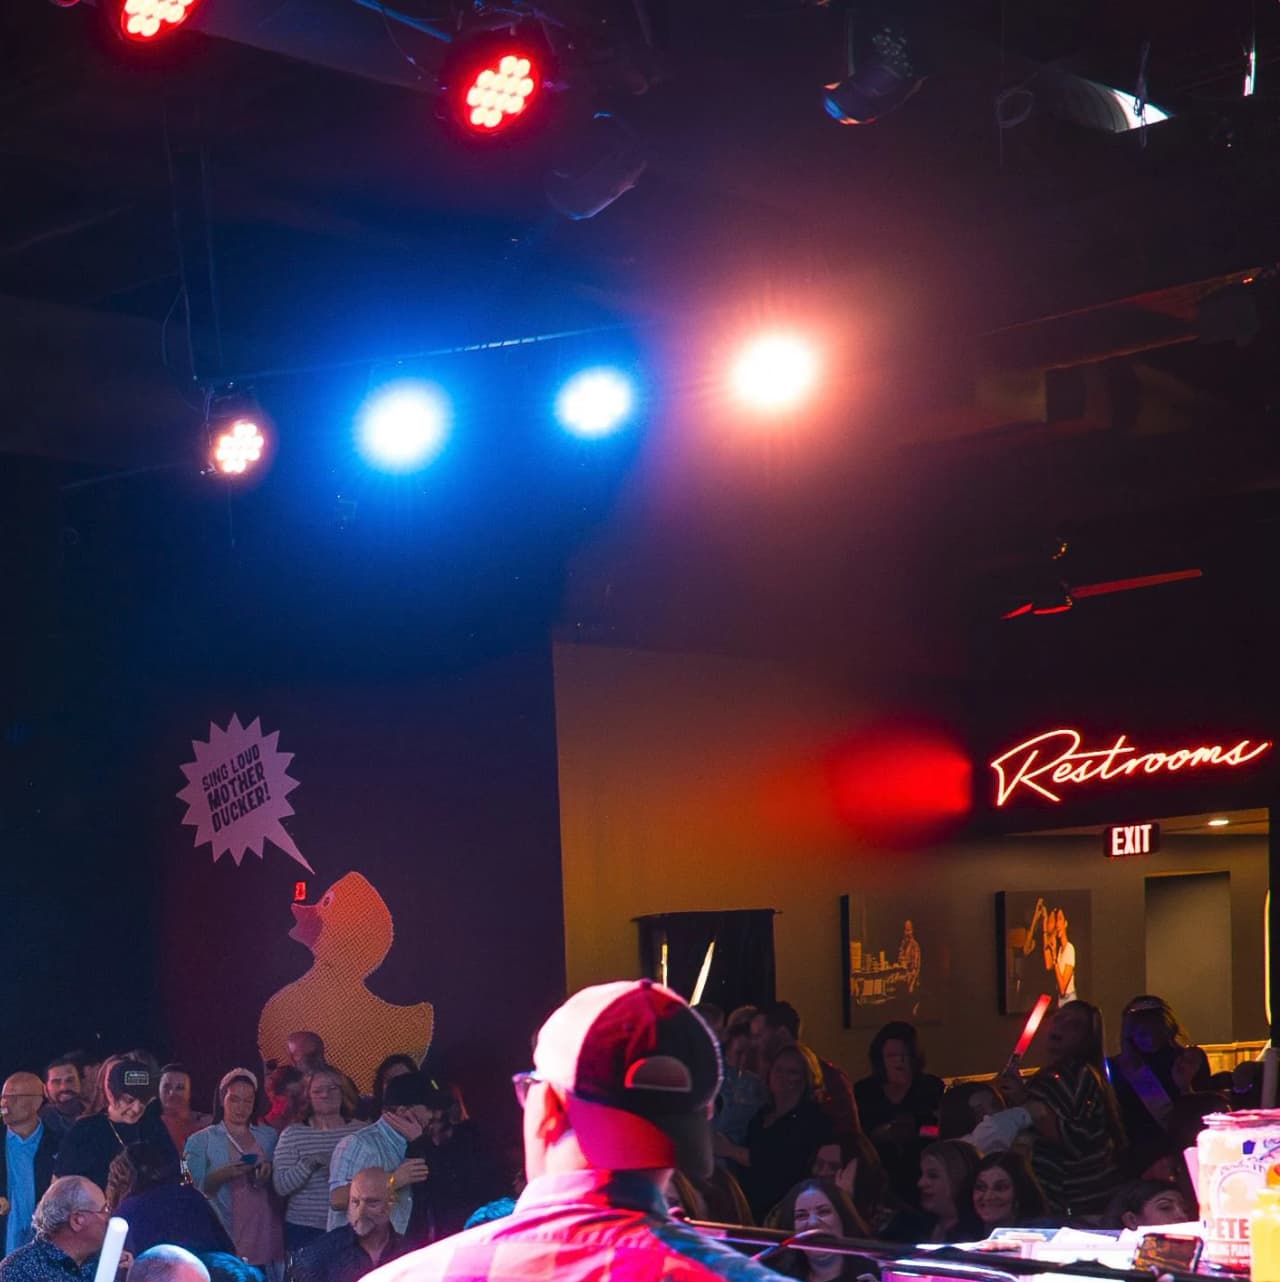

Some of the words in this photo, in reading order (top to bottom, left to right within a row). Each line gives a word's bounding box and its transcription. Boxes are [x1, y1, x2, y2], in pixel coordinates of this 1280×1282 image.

[201, 763, 229, 793] SING
[230, 743, 261, 774] LOUD
[207, 760, 266, 812] MOTHER
[990, 729, 1273, 807] Restrooms
[211, 781, 271, 833] DUCKER!
[1110, 823, 1152, 856] EXIT
